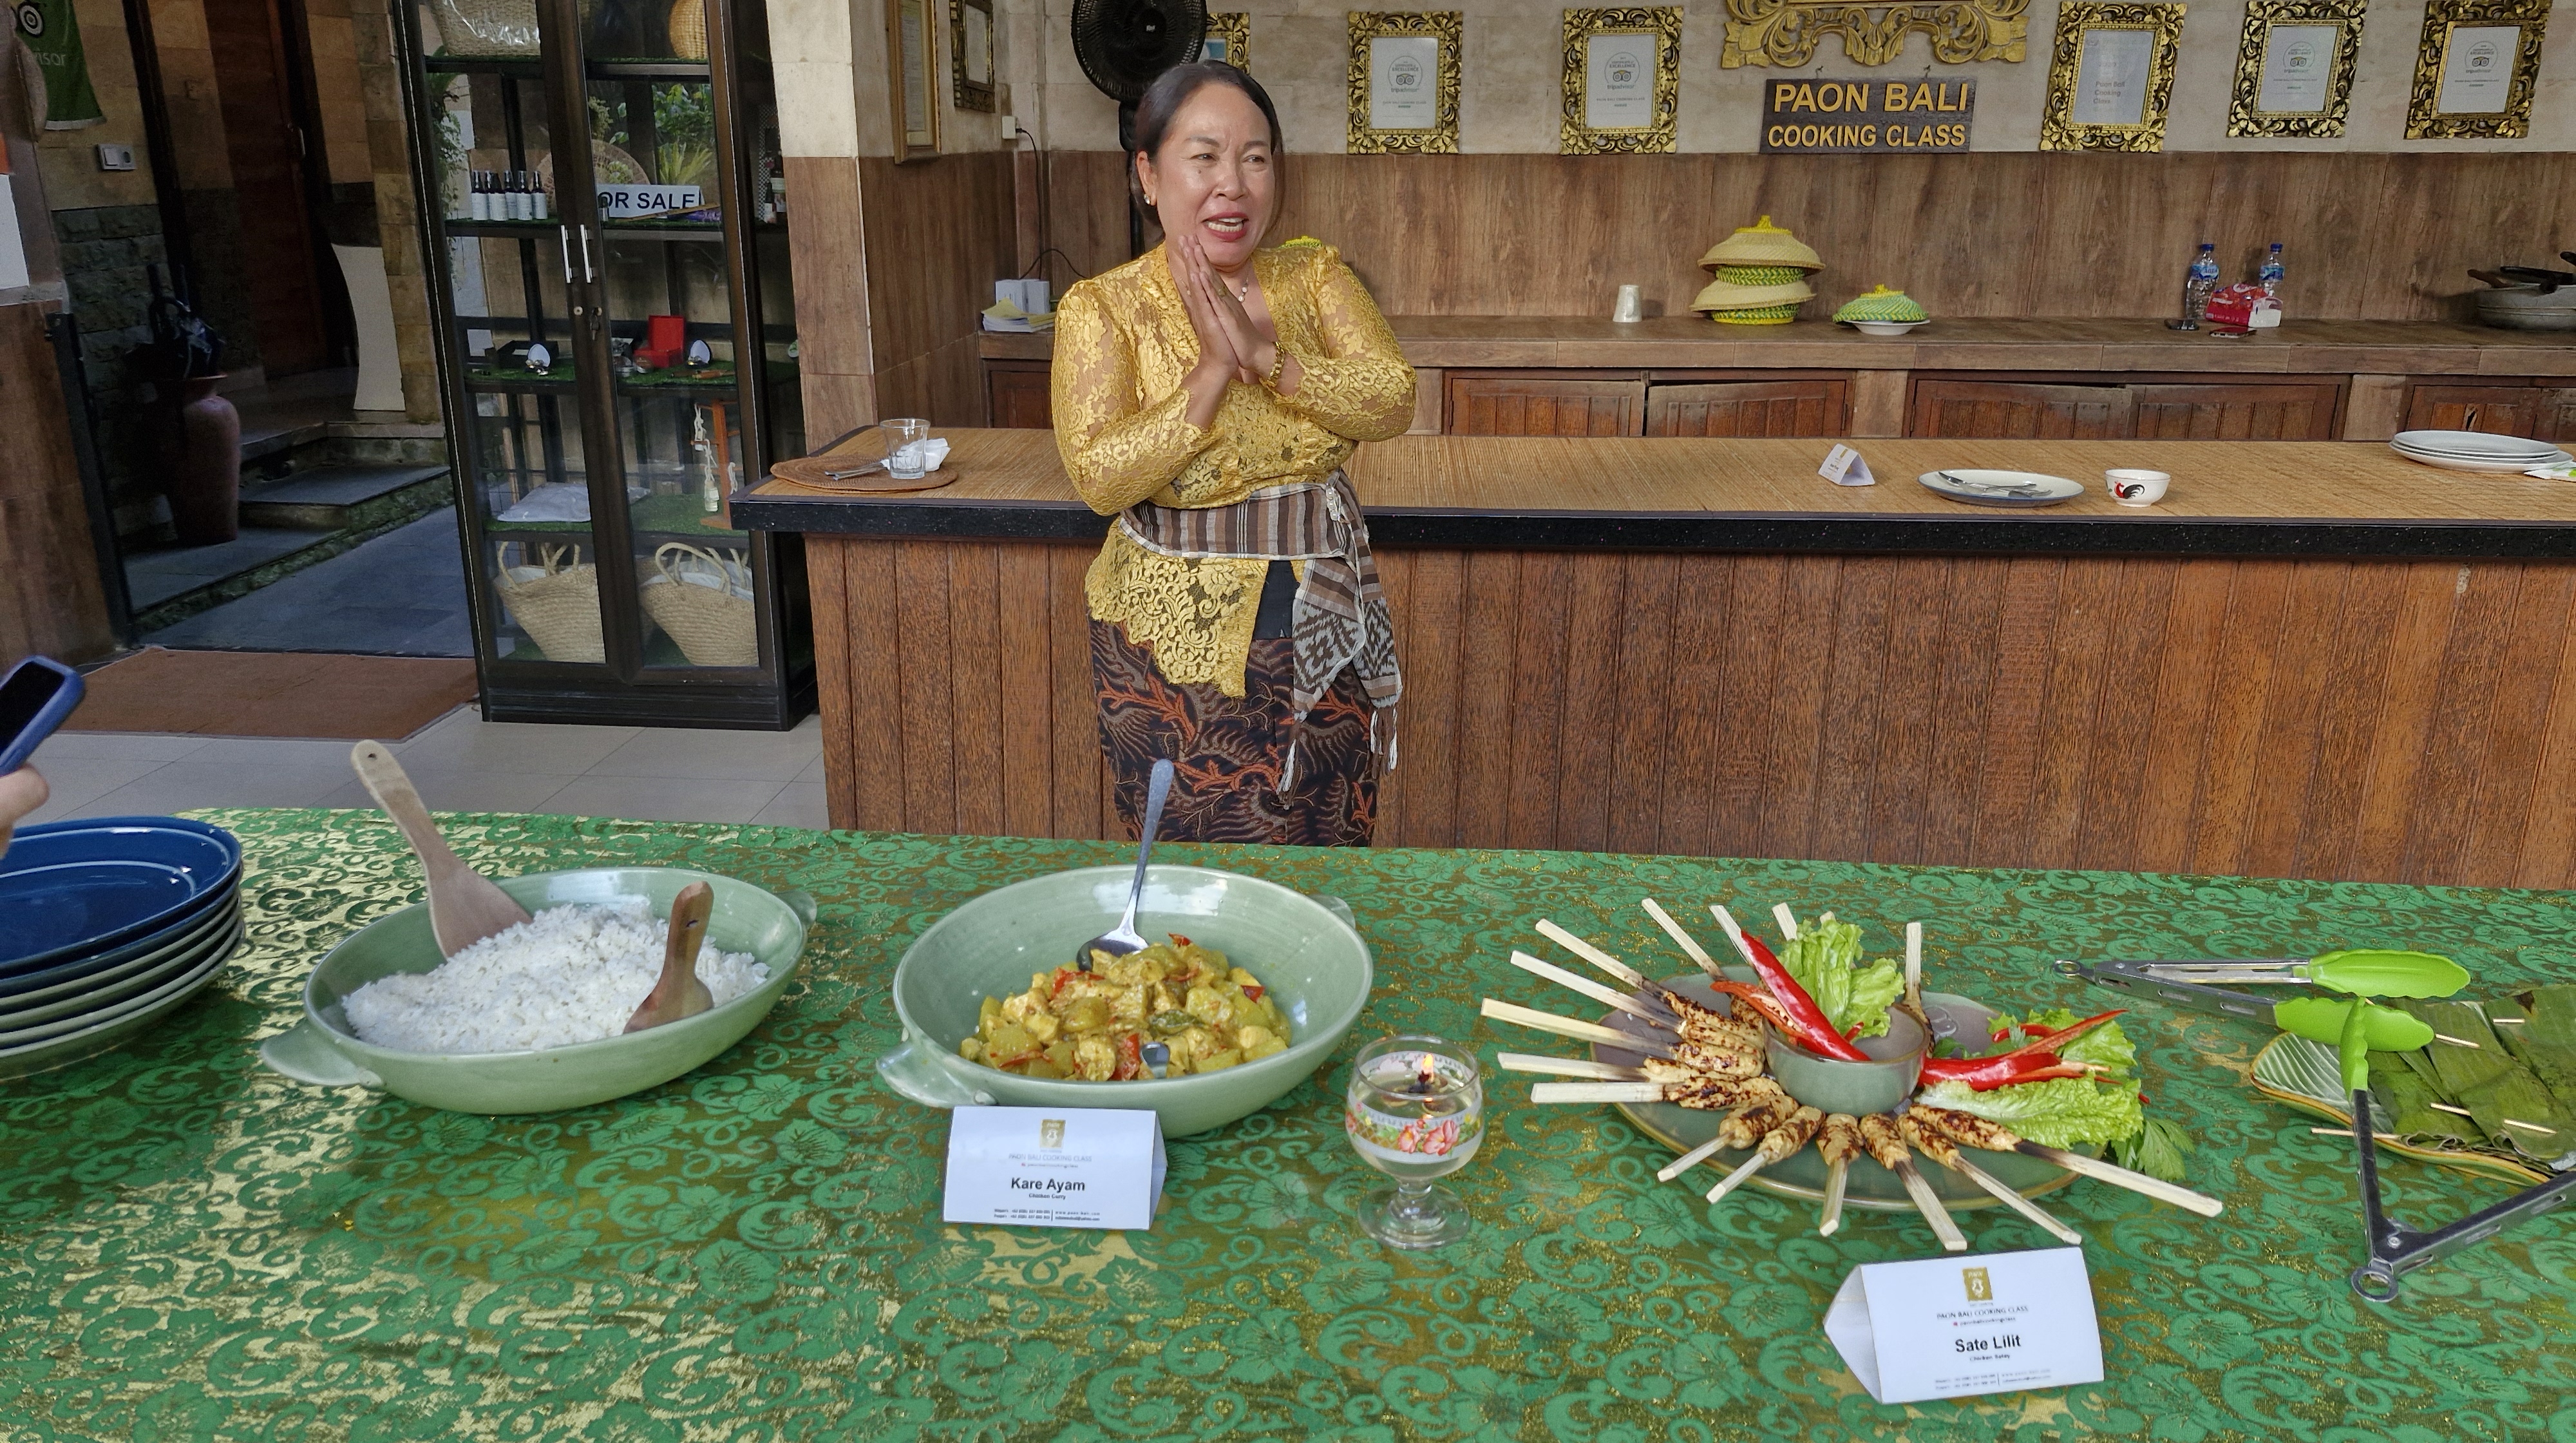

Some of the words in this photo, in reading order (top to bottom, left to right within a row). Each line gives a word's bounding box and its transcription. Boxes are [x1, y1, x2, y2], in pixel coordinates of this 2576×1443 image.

[1774, 83, 1869, 112] PAON
[1884, 83, 1968, 111] BALI
[1768, 124, 1877, 147] COOKING
[1886, 124, 1965, 147] CLASS
[598, 192, 629, 208] OR
[637, 193, 695, 209] SALE
[1011, 1177, 1043, 1190] Kare
[1046, 1178, 1085, 1193] Ayam
[1975, 1308, 2006, 1316] COOKING
[1955, 1338, 1988, 1353] Sate
[1993, 1334, 2022, 1349] Lilit
